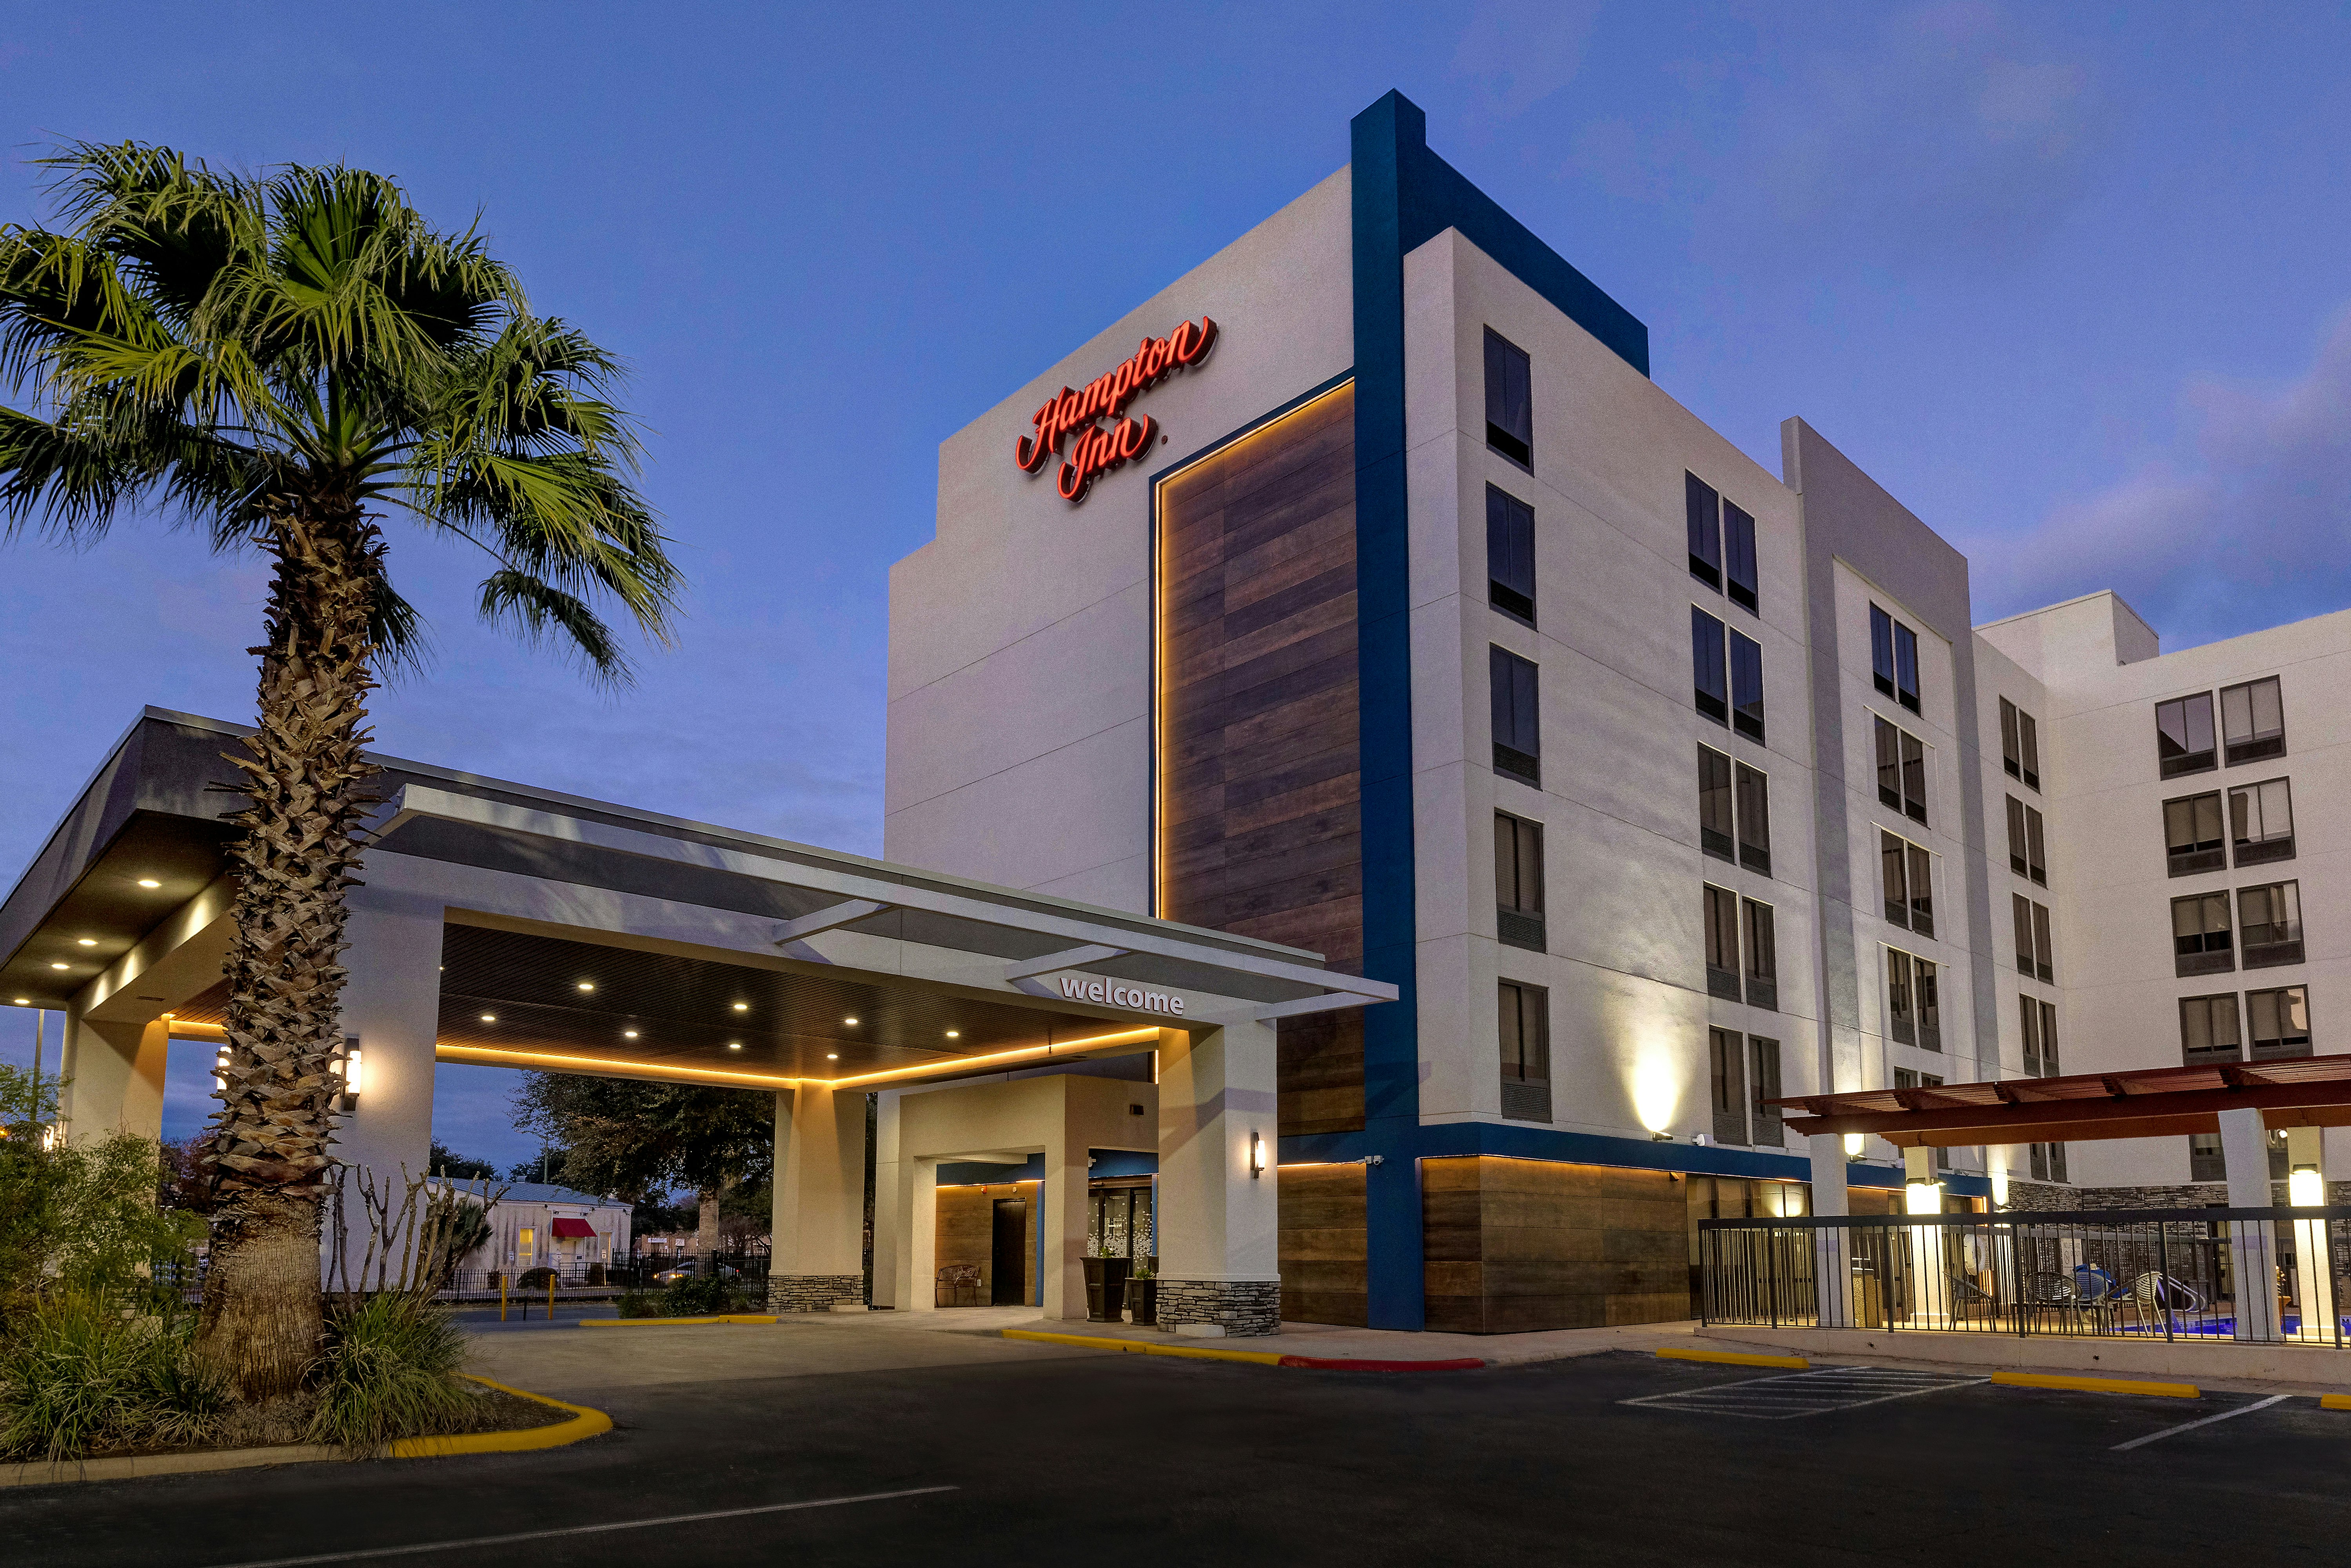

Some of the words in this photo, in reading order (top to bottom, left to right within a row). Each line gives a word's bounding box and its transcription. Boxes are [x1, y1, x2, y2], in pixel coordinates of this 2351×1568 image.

[1016, 315, 1215, 471] Hampton
[1057, 414, 1155, 500] Inn
[1060, 978, 1184, 1015] welcome
